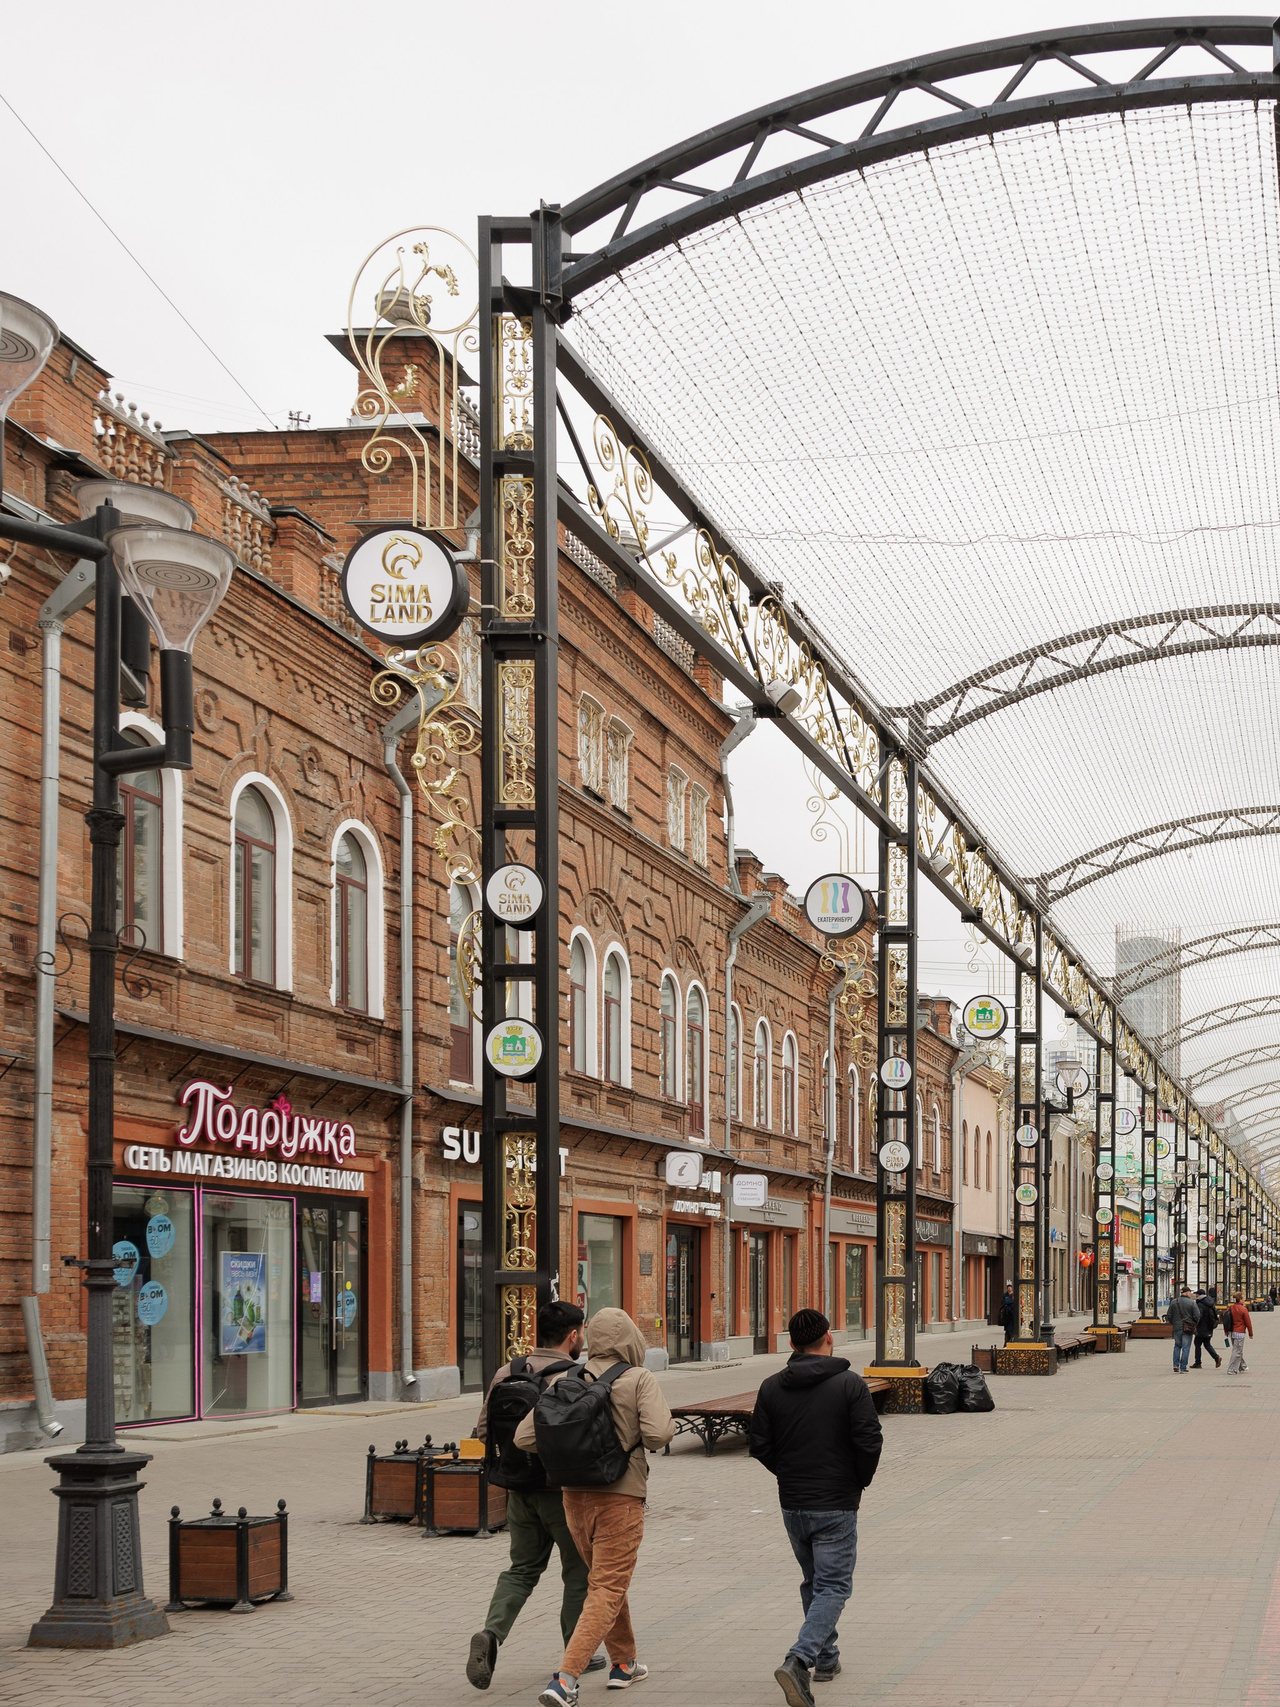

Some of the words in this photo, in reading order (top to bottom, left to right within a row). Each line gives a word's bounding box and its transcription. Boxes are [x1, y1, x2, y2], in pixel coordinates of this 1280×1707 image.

[370, 583, 432, 604] SIMA
[370, 604, 433, 624] LAND
[498, 893, 531, 904] SIMA
[498, 904, 532, 915] LAND
[179, 1080, 357, 1165] Подружка
[125, 1145, 172, 1172] СЕТЬ
[172, 1150, 278, 1183] МАГАЗИНОВ
[279, 1162, 365, 1192] КОСМЕТИКИ
[230, 1260, 256, 1269] СКИДКИ
